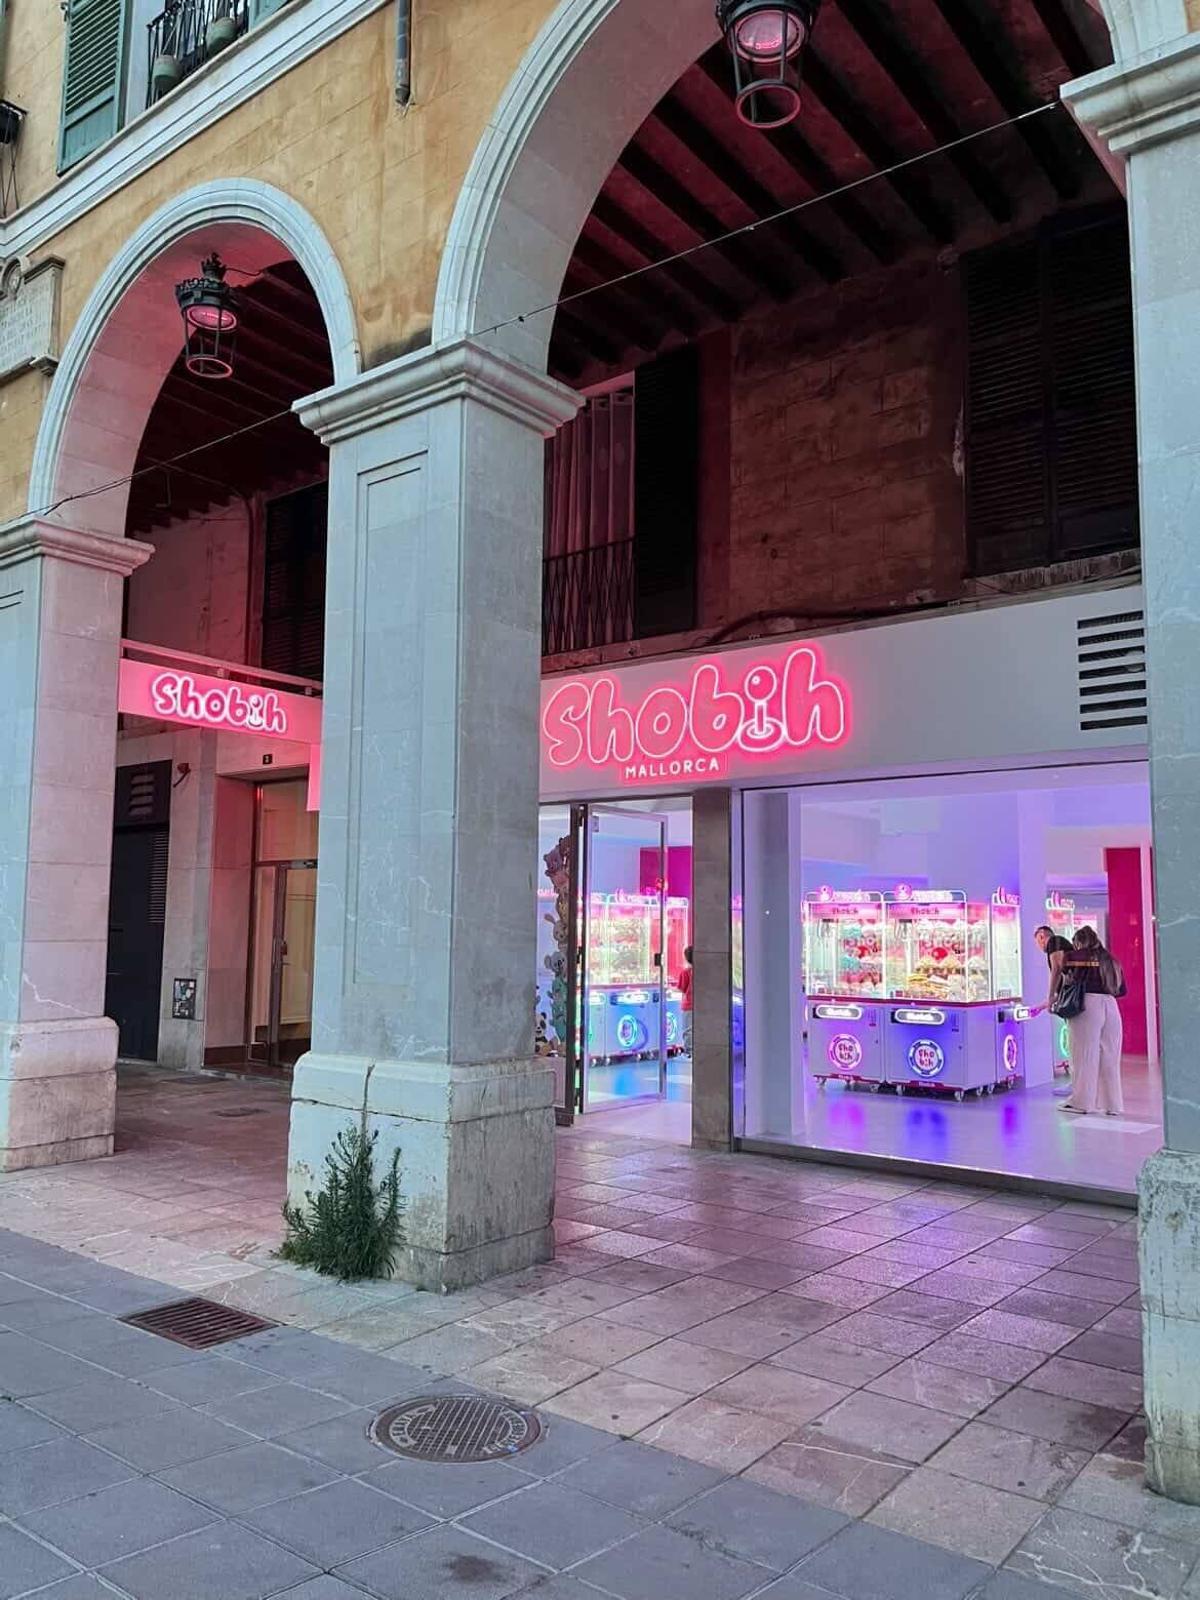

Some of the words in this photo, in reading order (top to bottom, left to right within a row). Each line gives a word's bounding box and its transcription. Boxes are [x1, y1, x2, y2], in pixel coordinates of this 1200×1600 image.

[152, 672, 287, 733] Shobih
[543, 648, 844, 765] Shobih
[625, 757, 720, 778] MALLORCA
